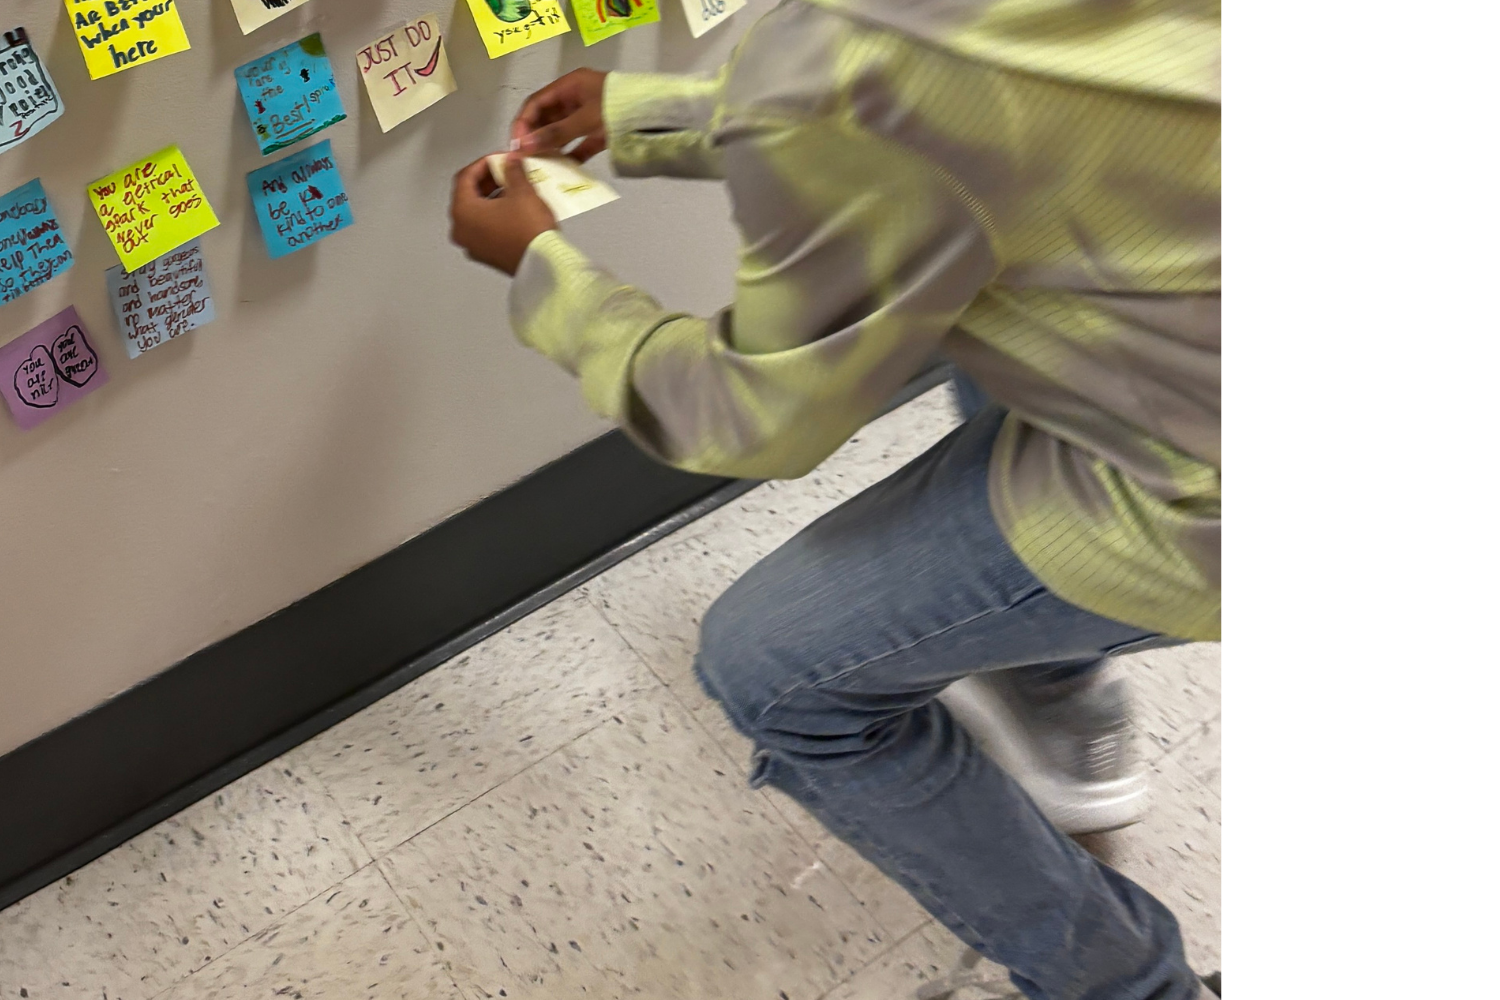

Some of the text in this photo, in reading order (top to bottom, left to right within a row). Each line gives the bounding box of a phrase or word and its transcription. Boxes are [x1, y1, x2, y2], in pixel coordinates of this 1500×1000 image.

[108, 39, 158, 69] here
[357, 19, 433, 74] JUST DO
[382, 61, 417, 98] IT
[123, 161, 158, 189] are
[160, 178, 195, 204] that
[99, 203, 115, 218] a
[268, 200, 290, 221] be
